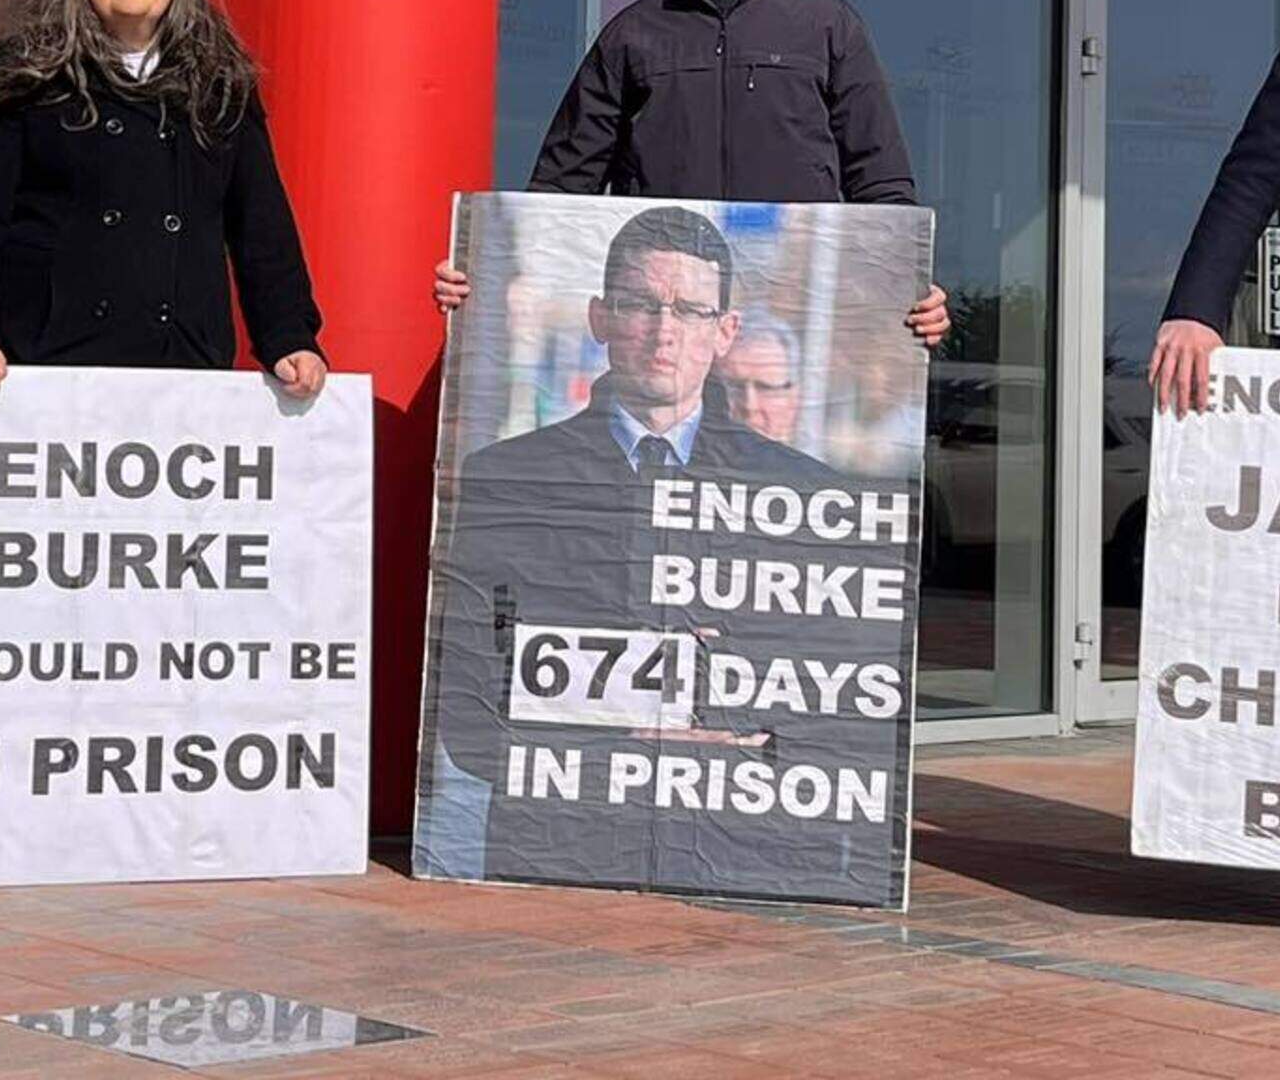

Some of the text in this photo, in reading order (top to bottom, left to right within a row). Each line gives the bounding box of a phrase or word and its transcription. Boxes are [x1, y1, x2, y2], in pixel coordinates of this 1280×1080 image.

[652, 479, 910, 543] ENOCH
[651, 554, 907, 621] BURKE
[159, 642, 271, 680] NOT
[290, 642, 357, 681] BE
[520, 632, 902, 719] 674 DAYS
[31, 732, 337, 796] PRISON
[507, 745, 888, 822] IN PRISON
